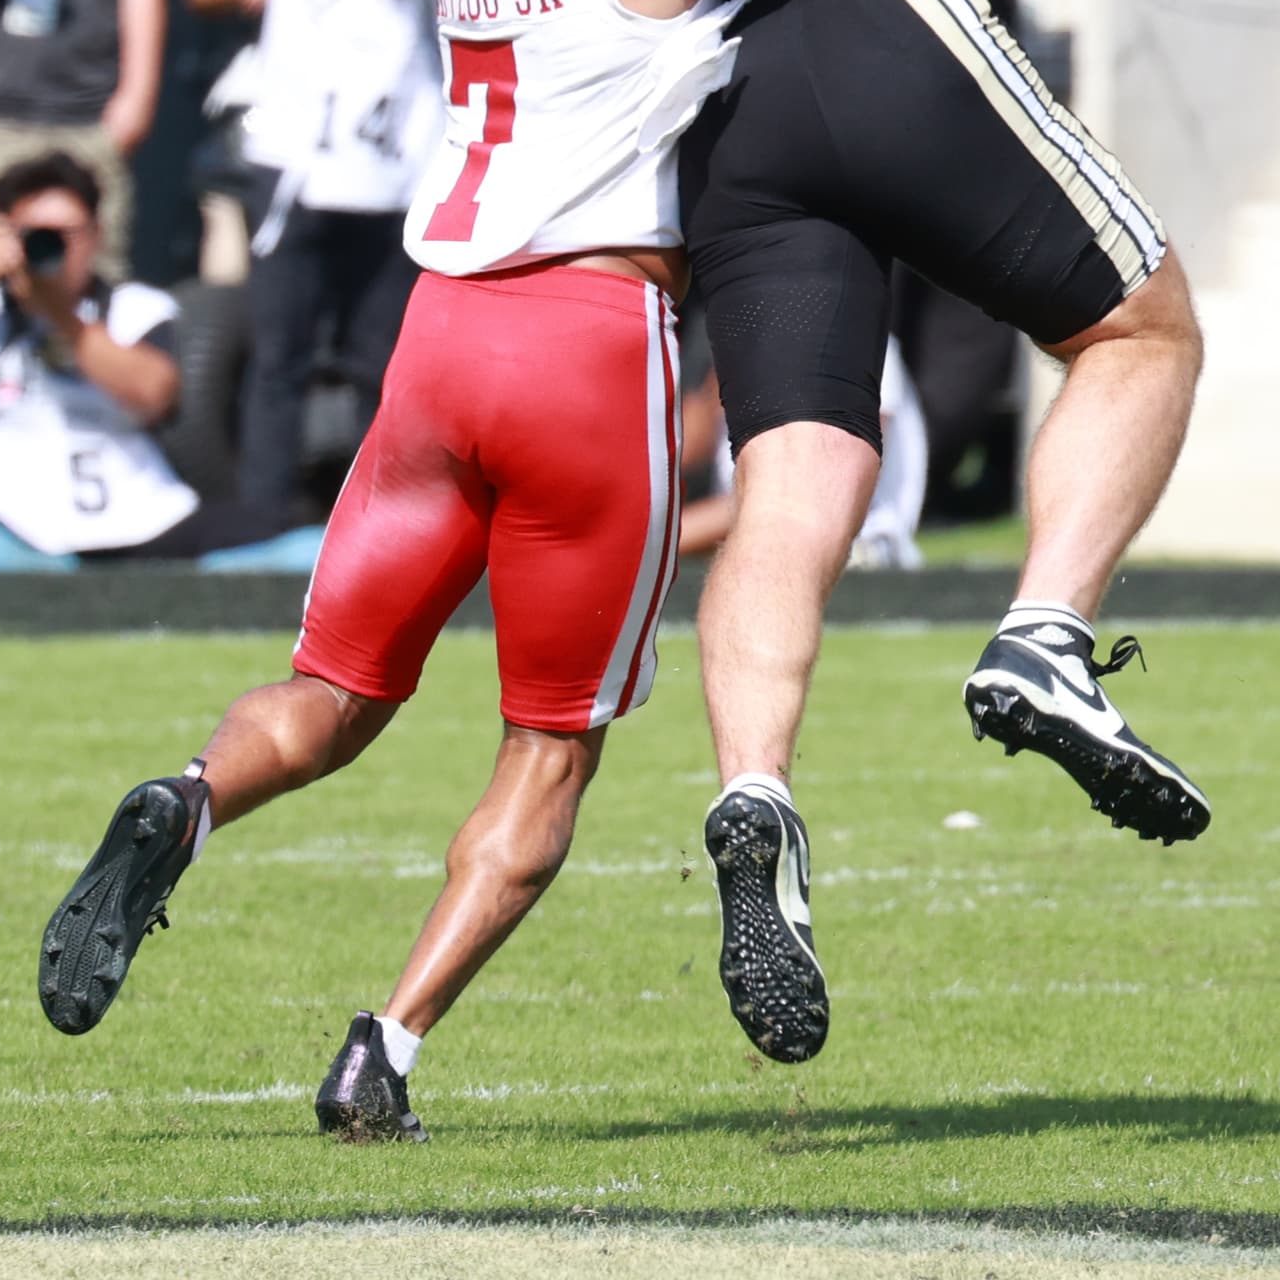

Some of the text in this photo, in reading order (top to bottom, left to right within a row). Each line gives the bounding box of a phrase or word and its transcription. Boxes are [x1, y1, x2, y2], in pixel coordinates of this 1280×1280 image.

[317, 91, 402, 160] 14
[422, 40, 518, 241] 7
[70, 451, 108, 516] 5
